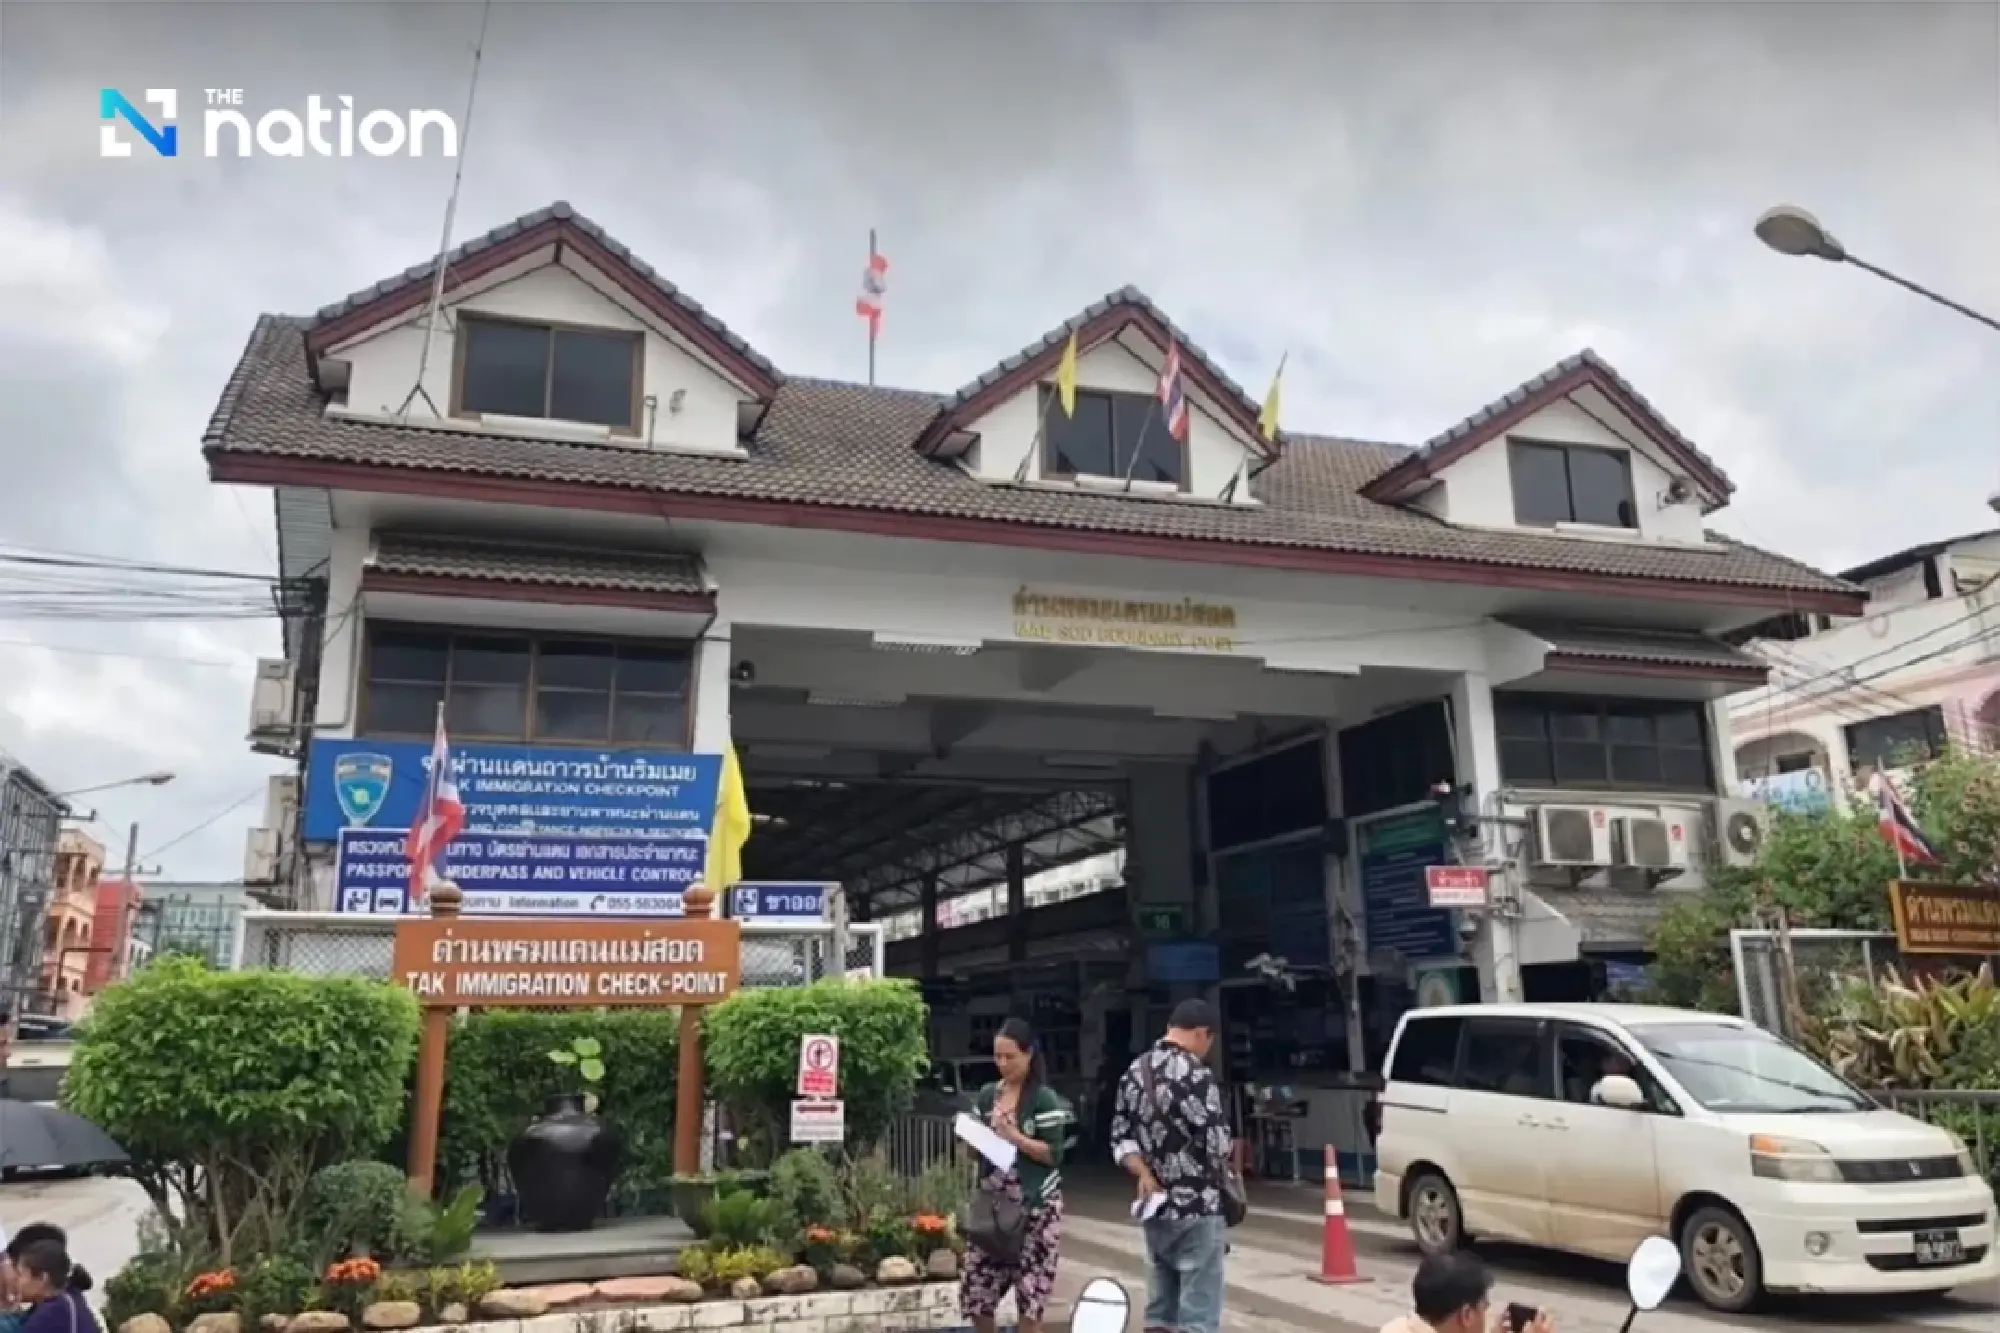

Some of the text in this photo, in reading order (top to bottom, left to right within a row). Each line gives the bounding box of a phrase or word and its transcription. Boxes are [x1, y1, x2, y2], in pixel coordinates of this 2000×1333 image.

[475, 779, 580, 795] IMMIGRATION
[584, 783, 680, 798] CHECKPOINT
[532, 866, 565, 880] AND
[569, 866, 627, 881] VEHICLE
[432, 928, 705, 964] ด่านพรมแดนแม่สอด
[406, 971, 728, 996] TAK IMMIGRATION CHECK-POINT
